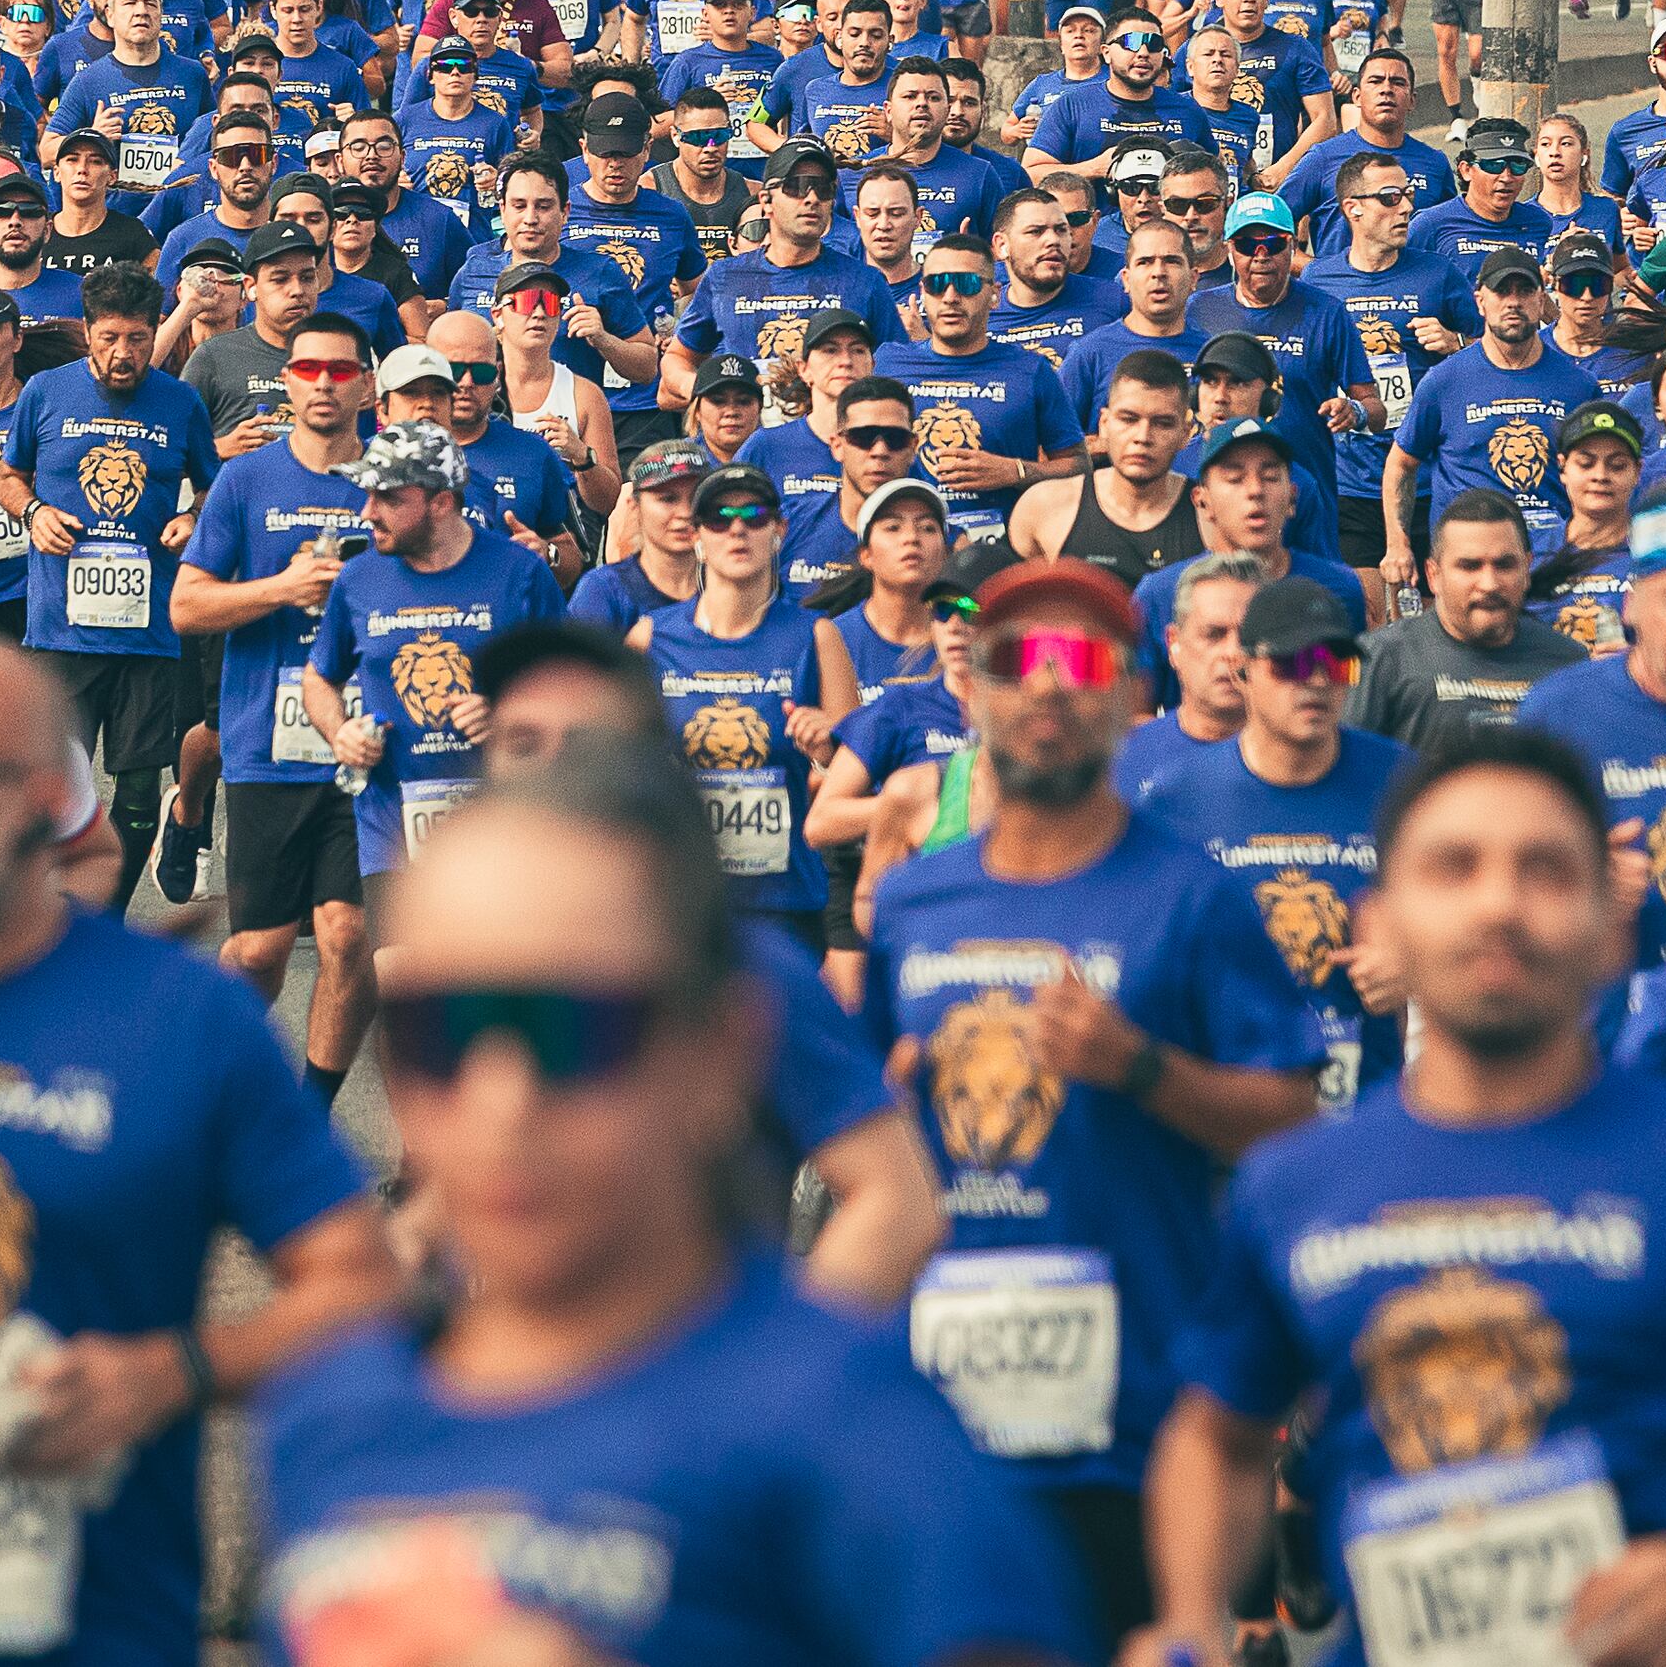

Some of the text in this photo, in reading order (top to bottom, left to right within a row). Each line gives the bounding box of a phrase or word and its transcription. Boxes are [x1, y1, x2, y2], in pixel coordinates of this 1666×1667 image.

[124, 149, 173, 171] 05704
[569, 226, 660, 240] RUNNERSTAR
[734, 298, 841, 312] RUNNERSTAR
[1466, 403, 1565, 420] RUNNERSTAR
[62, 423, 167, 445] RUNNERSTAR
[87, 528, 136, 540] LIFESTYLE
[73, 566, 145, 596] 09033
